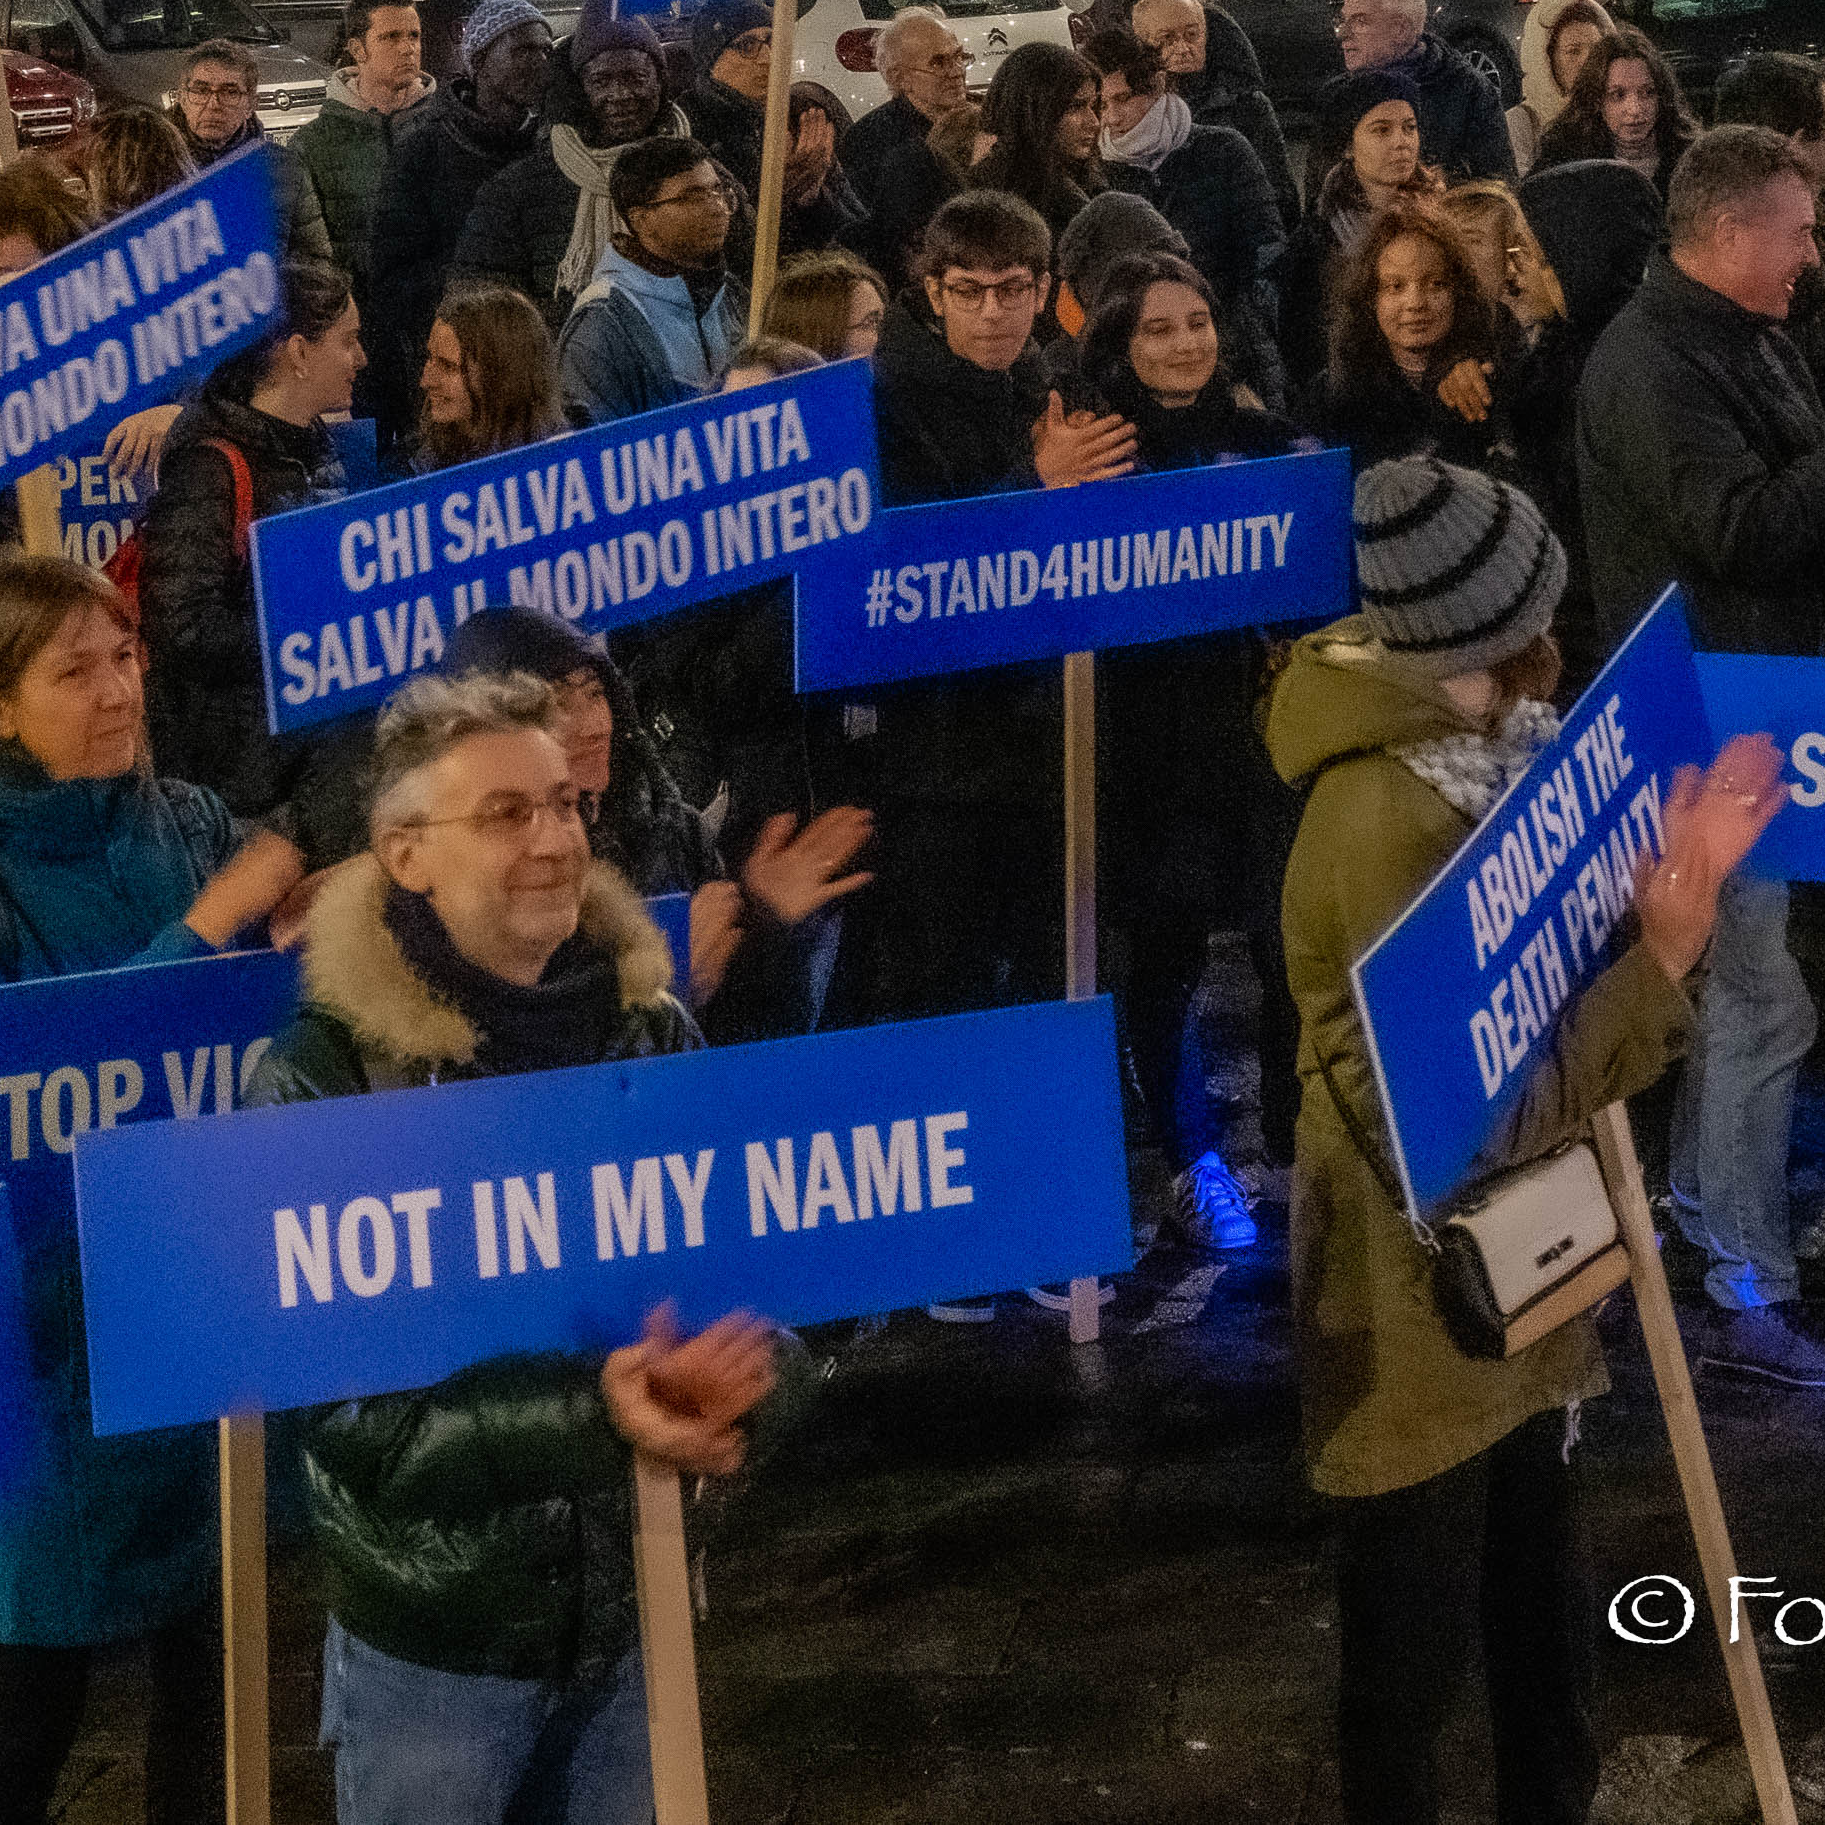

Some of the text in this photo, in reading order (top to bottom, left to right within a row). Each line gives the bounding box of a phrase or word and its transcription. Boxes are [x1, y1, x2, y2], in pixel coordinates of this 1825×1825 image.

[37, 249, 136, 347] UNA
[128, 199, 225, 298] VITA
[131, 251, 275, 384] INTERO
[279, 596, 446, 705] SALVA
[508, 520, 694, 620] MONDO
[703, 467, 872, 574] INTERO
[339, 398, 811, 592] CHI SALVA UNA VITA
[865, 512, 1294, 627] #STAND4HUMANITY
[1467, 694, 1634, 971] ABOLISH THE
[1469, 917, 1569, 1100] DEATH
[274, 1110, 975, 1308] NOT IN MY NAME
